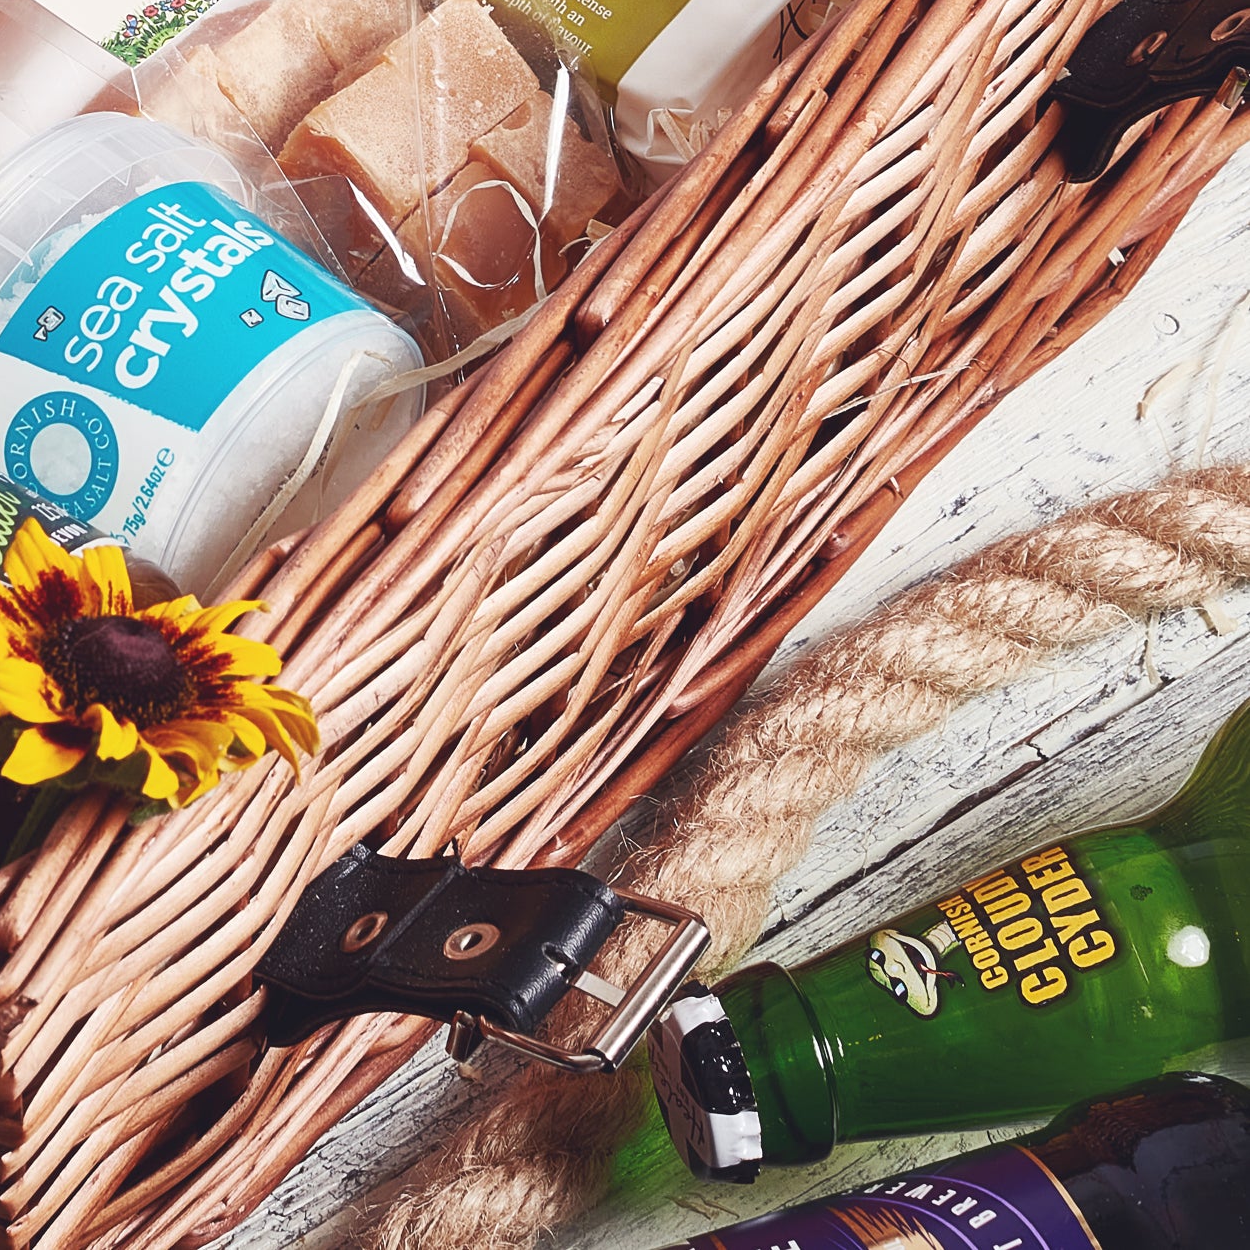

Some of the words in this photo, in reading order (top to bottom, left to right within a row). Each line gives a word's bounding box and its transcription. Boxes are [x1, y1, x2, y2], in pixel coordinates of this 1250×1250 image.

[567, 10, 585, 27] an
[64, 275, 143, 372] sea
[125, 201, 207, 273] salt
[114, 218, 274, 390] crystals
[84, 457, 112, 507] SALT
[937, 895, 1009, 990] CORNISH
[1021, 846, 1115, 968] CYDER
[841, 1182, 997, 1229] BREWER
